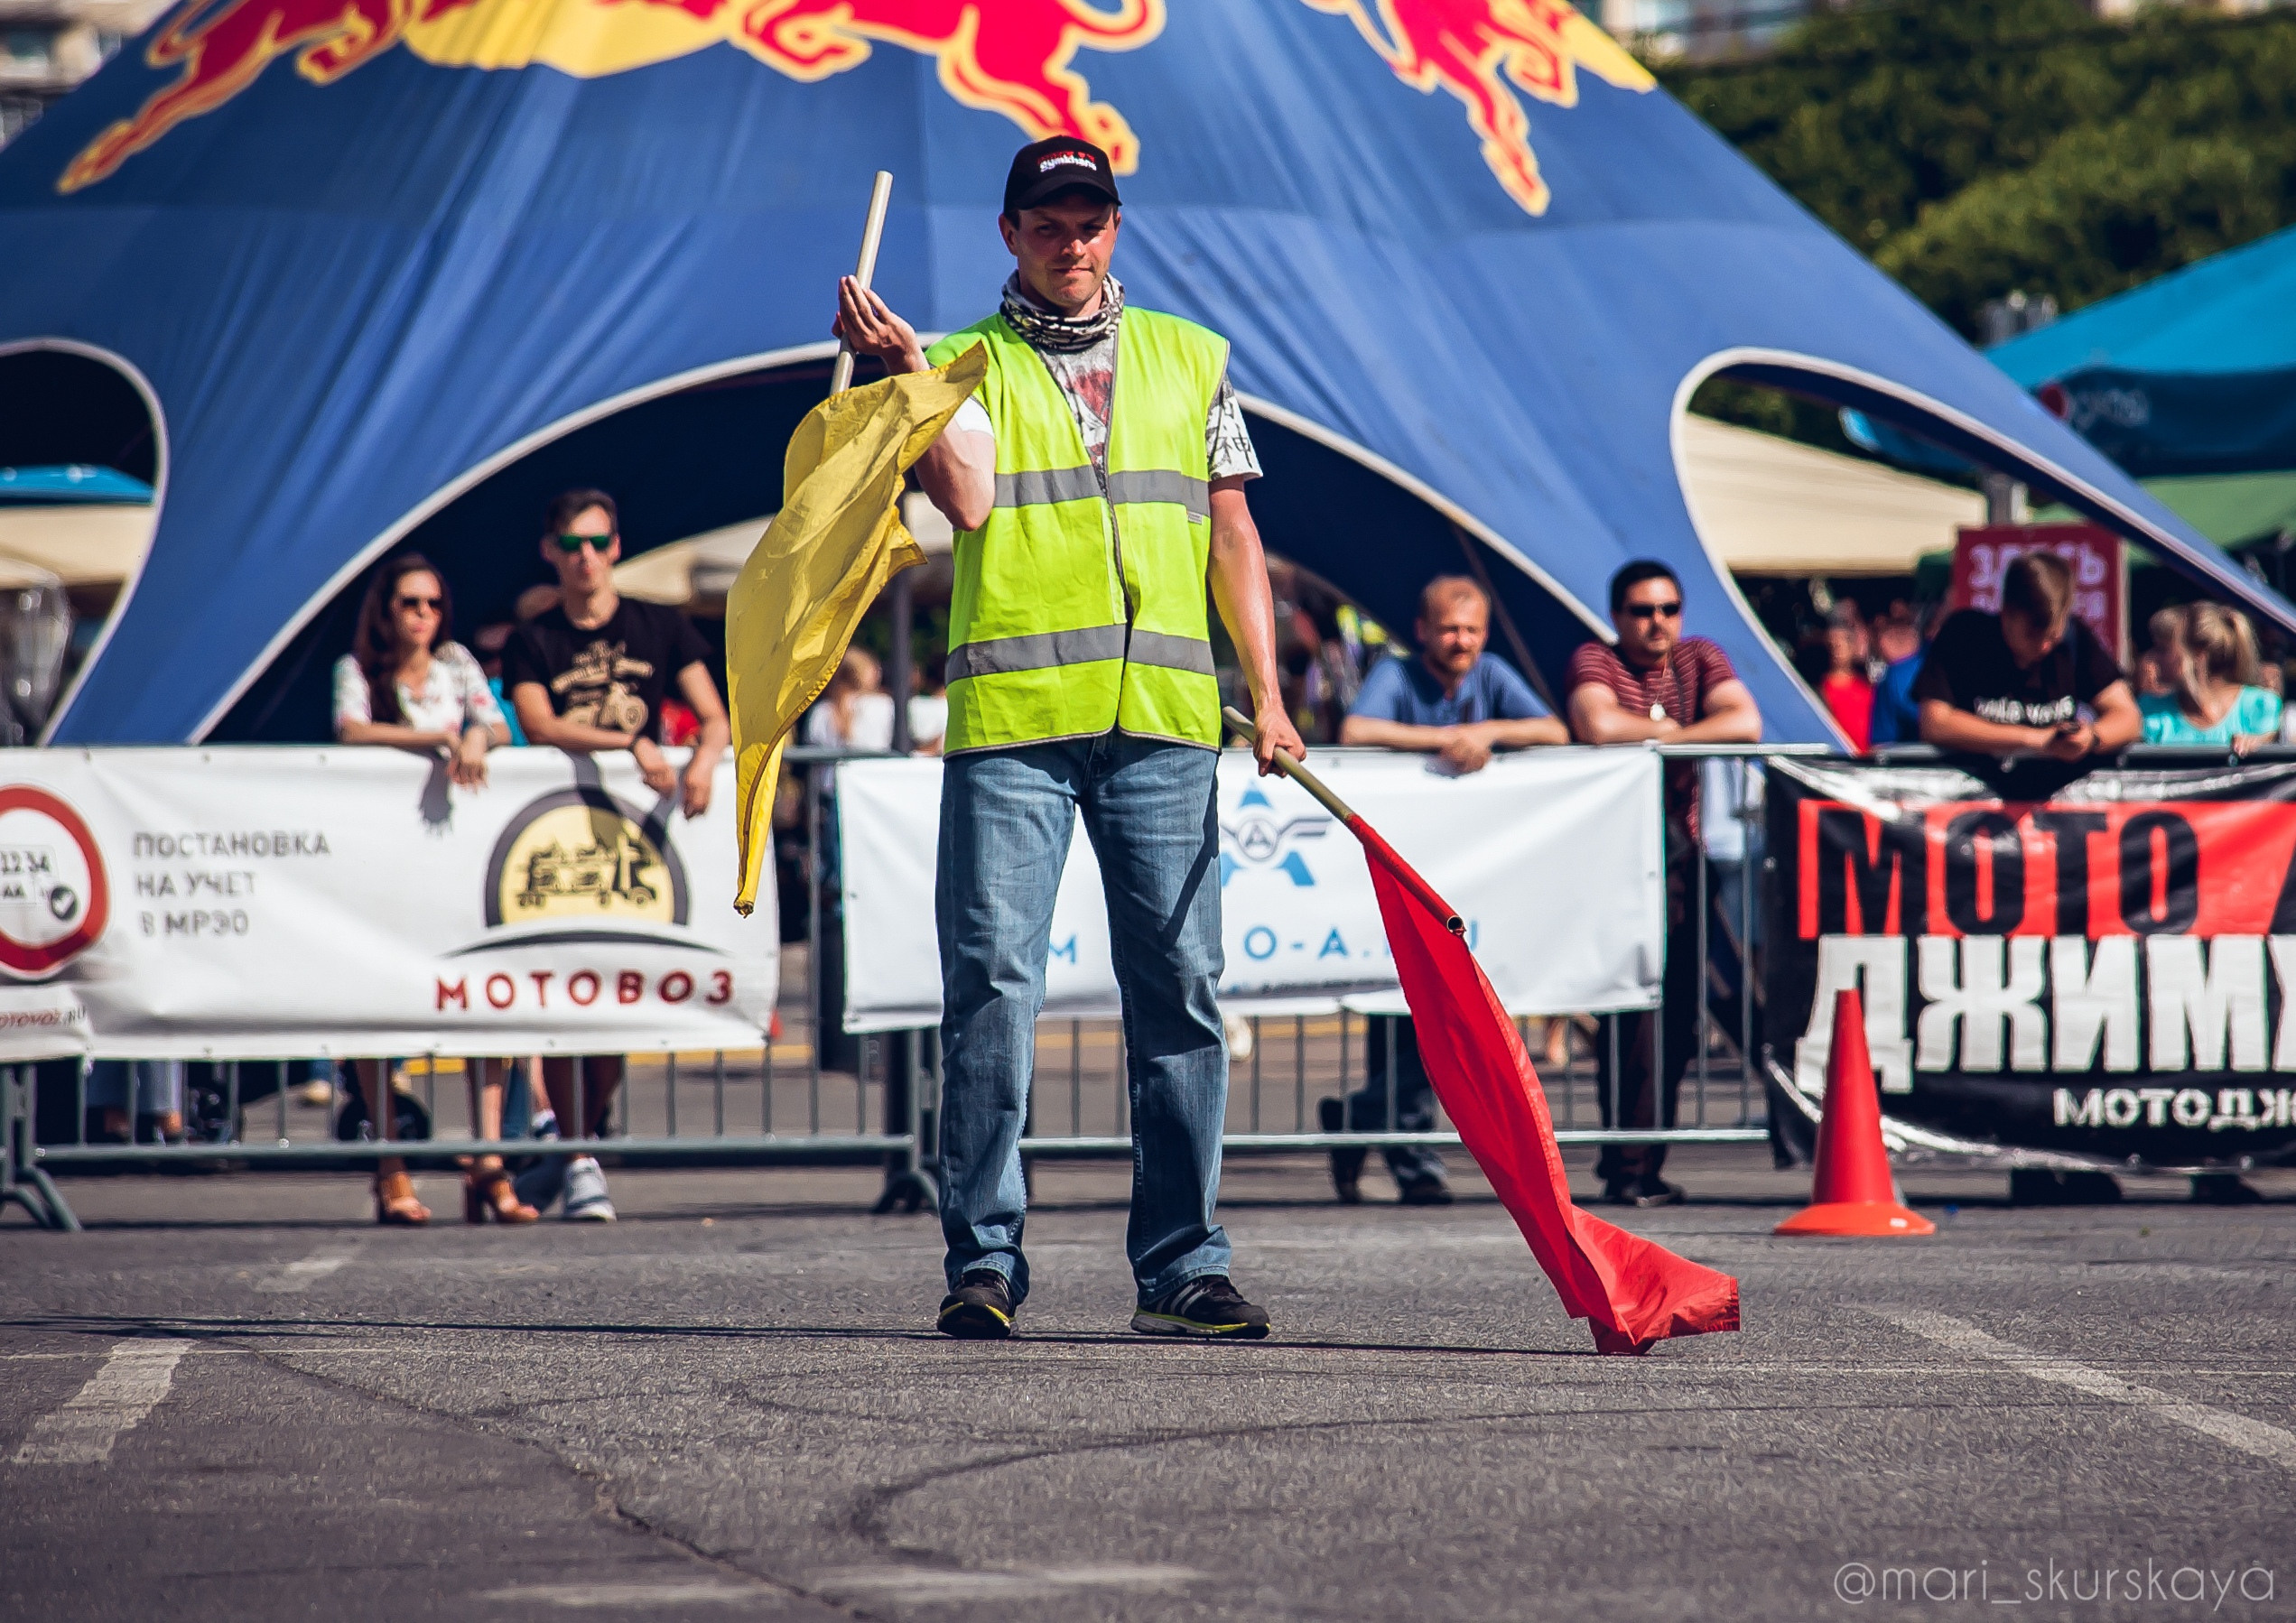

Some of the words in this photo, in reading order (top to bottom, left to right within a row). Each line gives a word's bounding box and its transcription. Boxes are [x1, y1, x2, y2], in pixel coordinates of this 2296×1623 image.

[133, 831, 331, 858] ПОСТАНОВКА
[135, 872, 176, 898] НА
[185, 870, 256, 897] УЧЕТ
[1817, 808, 2199, 936] МОТО
[164, 909, 250, 936] МРЭО
[435, 969, 734, 1011] МОТОВОЗ
